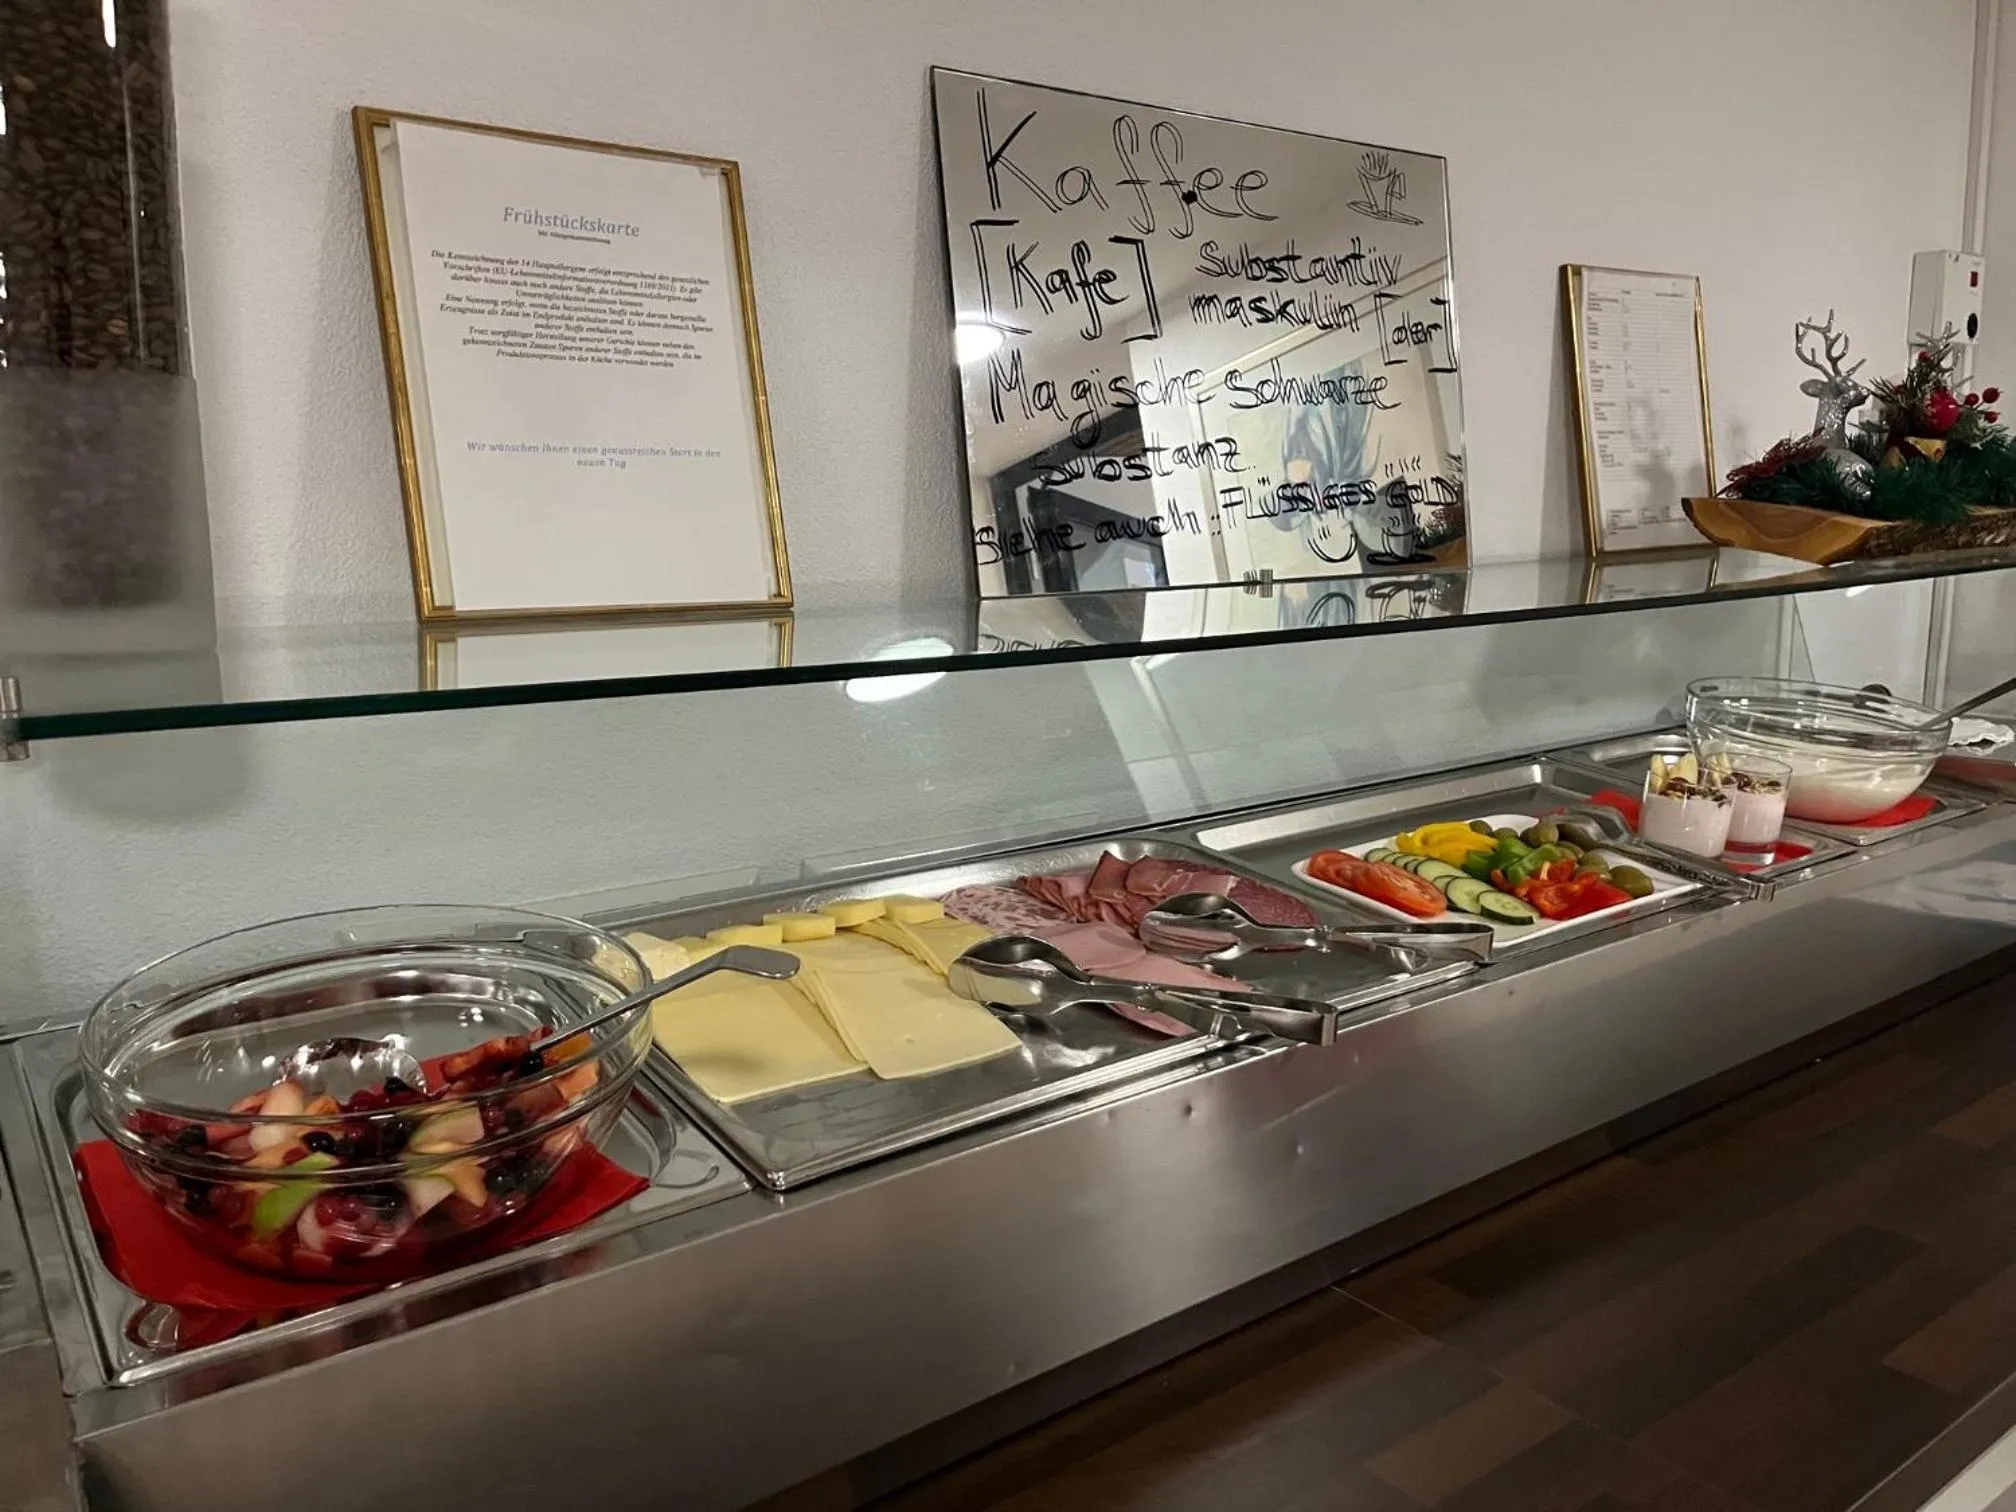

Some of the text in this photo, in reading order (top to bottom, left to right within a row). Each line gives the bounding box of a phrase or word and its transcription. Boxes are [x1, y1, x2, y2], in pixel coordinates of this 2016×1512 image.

[976, 86, 1279, 239] Kaffee
[503, 206, 640, 237] Frühstückskarte
[1196, 237, 1401, 286] Substantiv
[1189, 290, 1359, 333] maskulin
[988, 350, 1215, 448] Magische
[467, 442, 485, 451] Wir
[489, 442, 539, 452] wünschen
[542, 444, 570, 453] Ihnen
